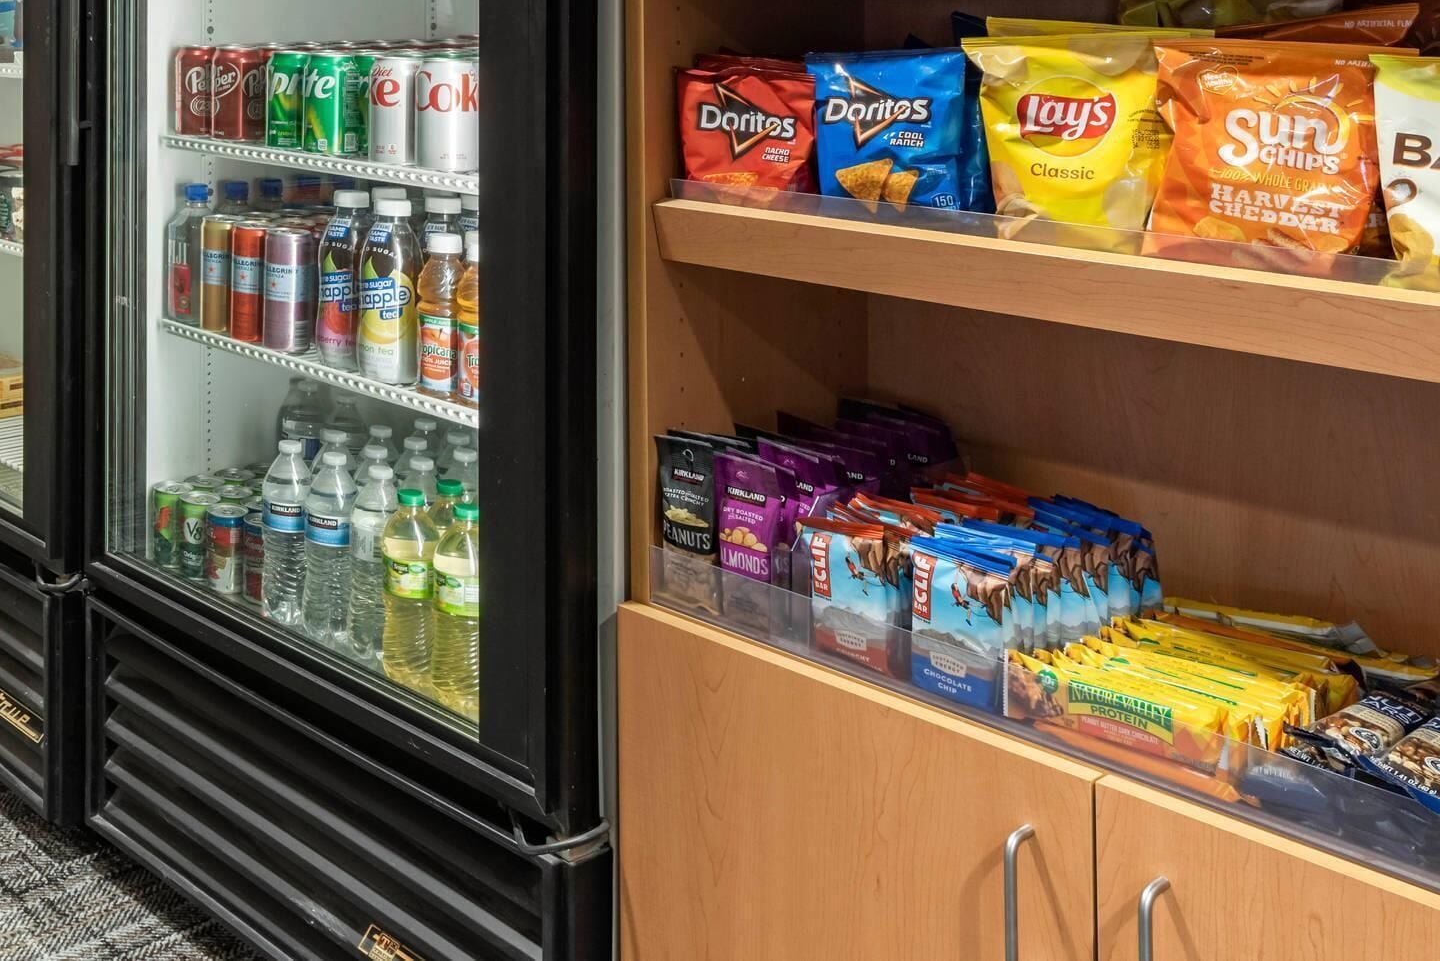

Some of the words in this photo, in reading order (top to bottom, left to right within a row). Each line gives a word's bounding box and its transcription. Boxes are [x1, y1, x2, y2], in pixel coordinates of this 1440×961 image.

[371, 64, 393, 77] Diet
[415, 69, 479, 113] Cok
[824, 97, 930, 122] Doritos
[1024, 94, 1112, 141] Lay's
[700, 103, 796, 139] Doritos
[889, 137, 924, 147] RANCH
[898, 130, 924, 140] COOL
[1219, 107, 1347, 167] Sun
[761, 153, 790, 164] CHEESE
[764, 146, 791, 156] NACHO
[1392, 131, 1440, 169] B
[1260, 146, 1341, 175] CHIPS
[1030, 162, 1095, 180] Classic
[1255, 172, 1292, 189] WHOLE
[934, 194, 954, 207] 150
[1211, 182, 1344, 219] HARVEST
[1209, 199, 1340, 235] CHEDDAR
[369, 279, 394, 290] sugar
[382, 309, 399, 319] tea
[422, 341, 458, 359] opicana
[674, 468, 705, 481] KIRKLAND
[727, 486, 766, 503] KIRKLAND
[795, 480, 814, 493] LAND
[271, 504, 301, 514] KIRKLAND
[736, 508, 764, 521] ROASTED
[185, 520, 203, 541] V8
[663, 519, 712, 550] PEANUTS
[811, 532, 828, 582] CLIF
[814, 580, 829, 592] BAR
[914, 555, 931, 604] CLIF
[913, 600, 929, 614] BAR
[923, 668, 973, 693] CHOCOLATE
[937, 682, 958, 695] CHIP
[1090, 705, 1149, 730] PROTEIN
[1393, 769, 1408, 781] 1.41
[1407, 777, 1419, 786] OZ
